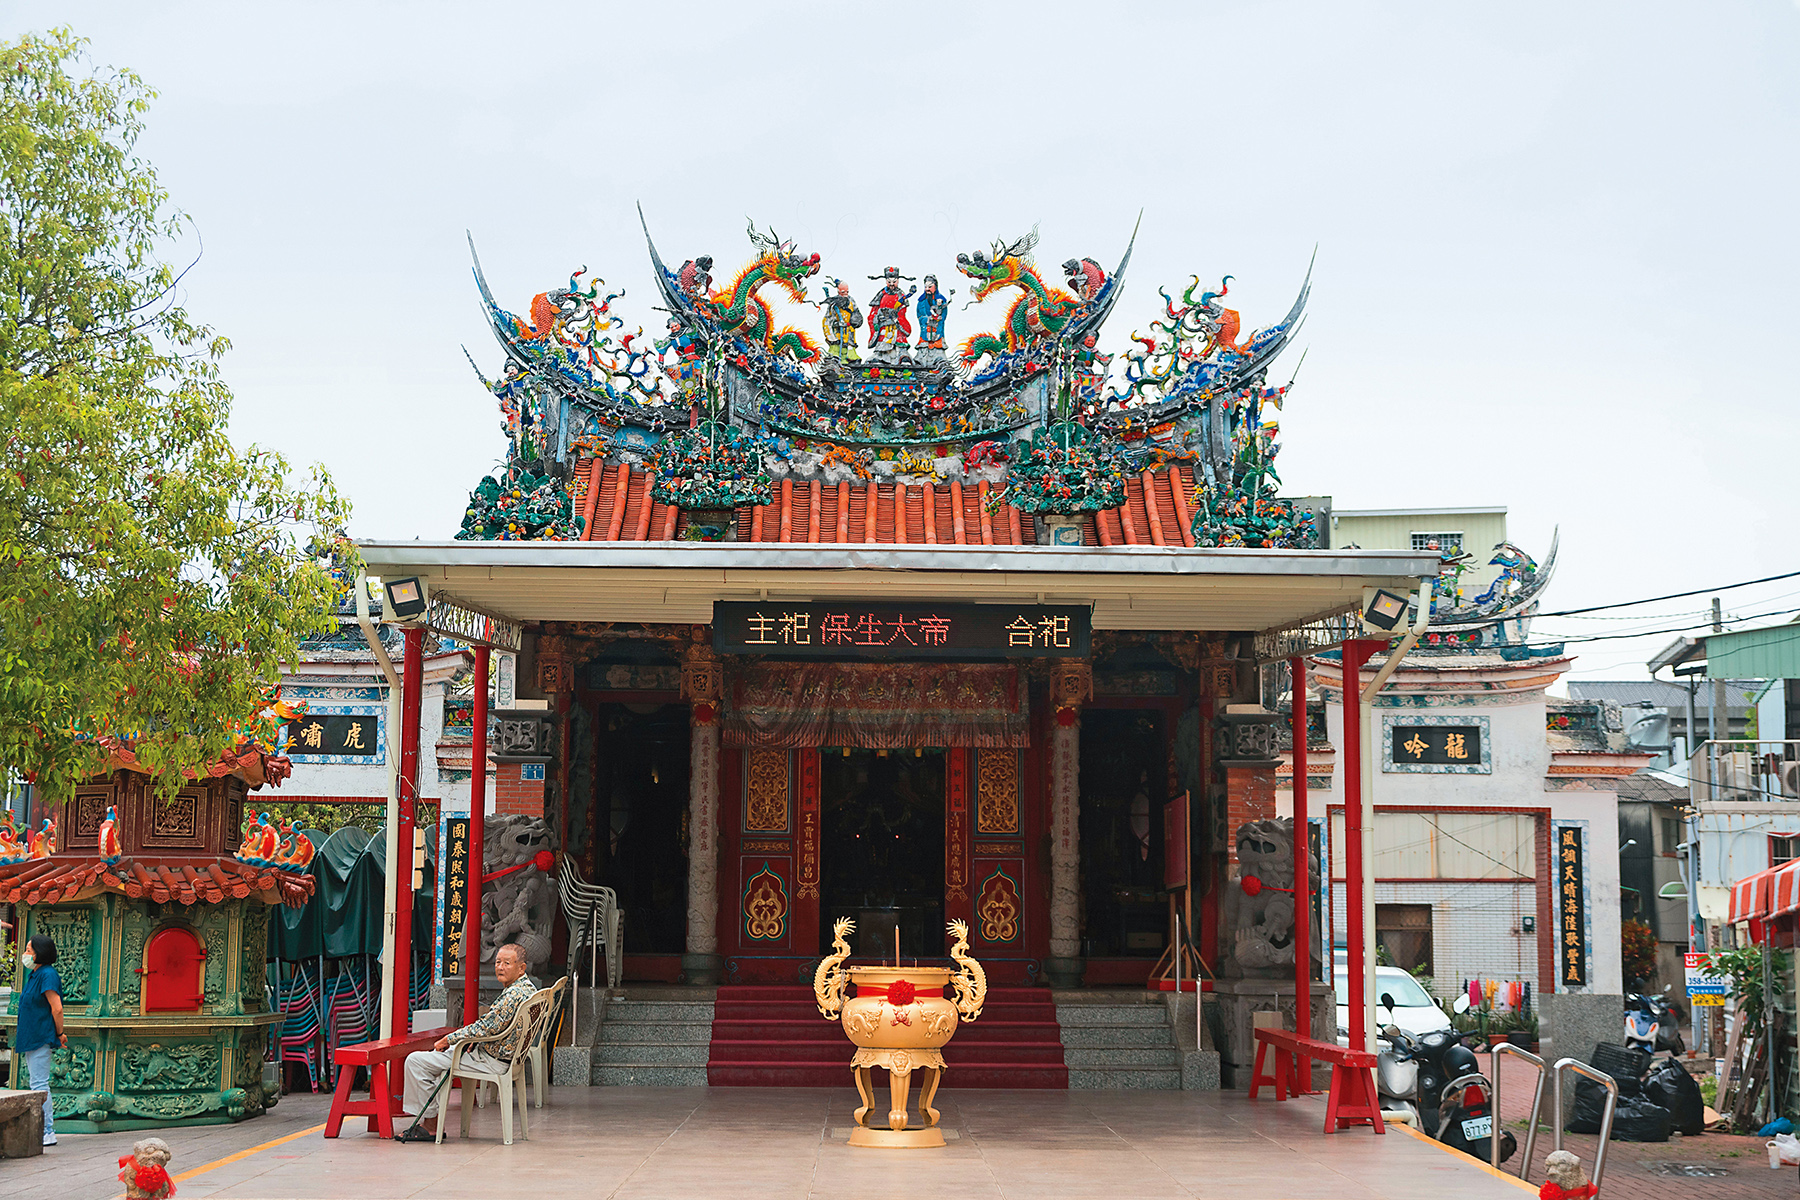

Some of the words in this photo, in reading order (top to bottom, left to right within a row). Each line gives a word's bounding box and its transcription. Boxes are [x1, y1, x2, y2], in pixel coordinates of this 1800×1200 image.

[745, 612, 811, 645] 主祀
[820, 613, 951, 647] 保生大帝
[1005, 614, 1071, 648] 合祀
